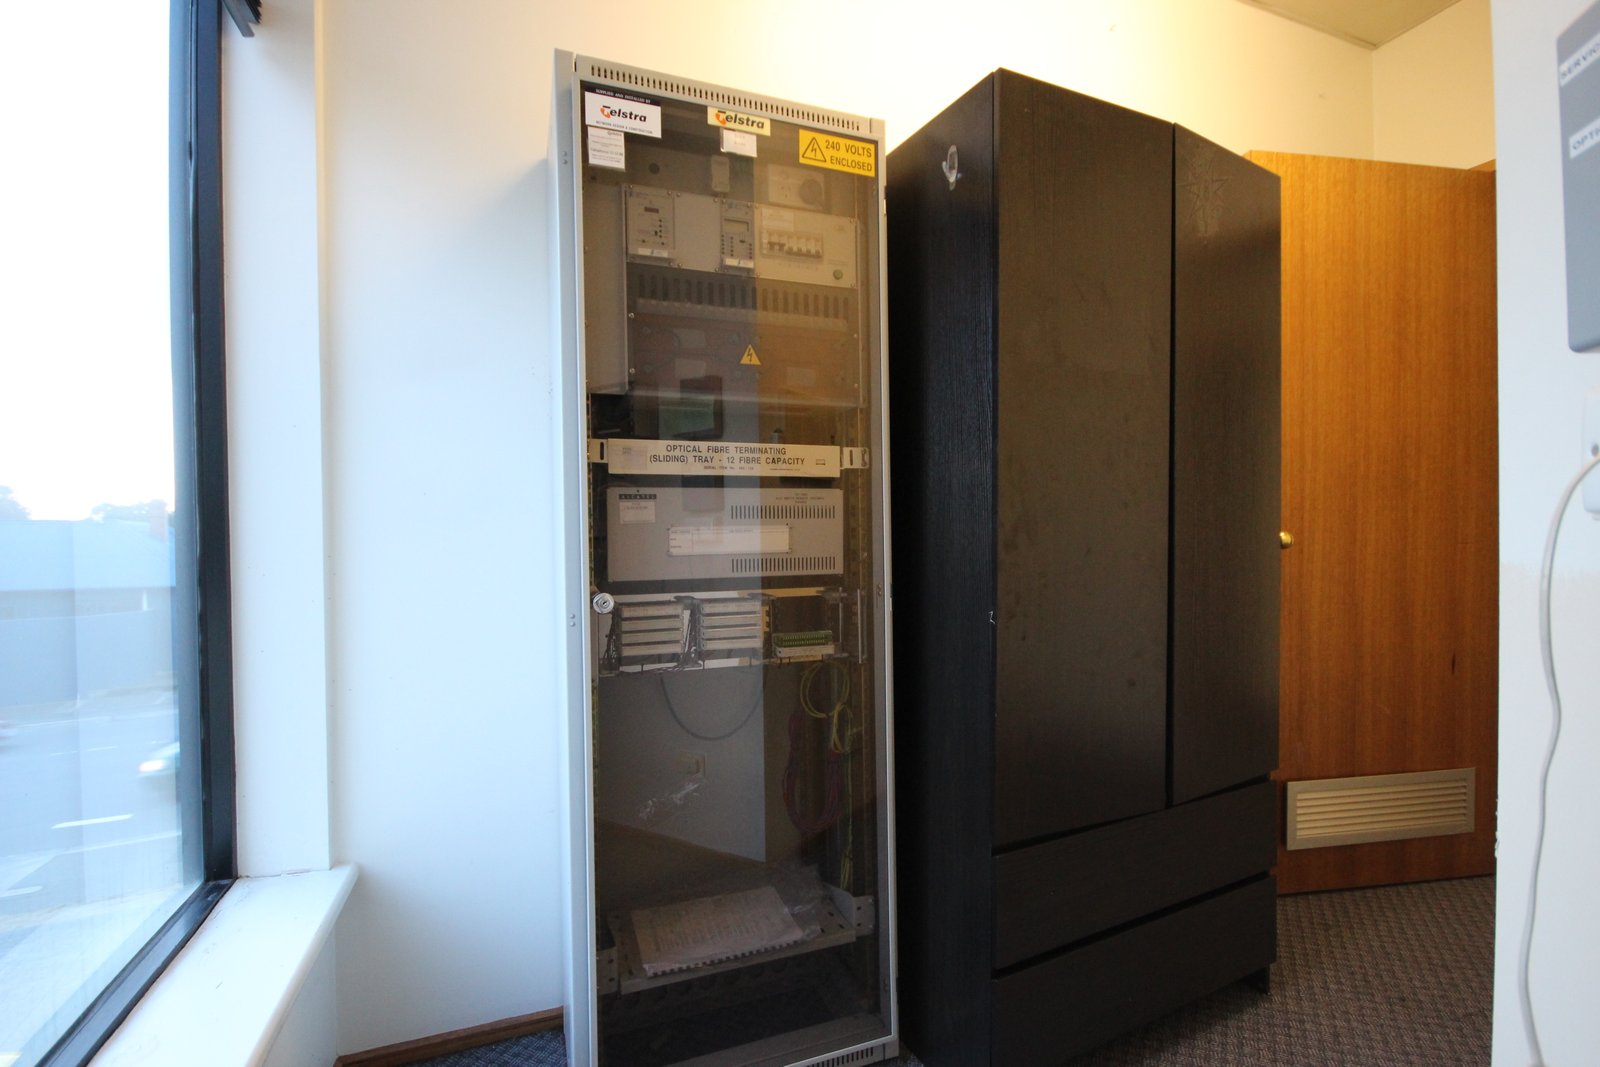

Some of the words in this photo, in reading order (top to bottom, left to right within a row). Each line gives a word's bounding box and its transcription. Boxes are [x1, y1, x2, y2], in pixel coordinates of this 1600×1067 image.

[600, 105, 647, 123] Telstra
[715, 110, 765, 129] Telstra
[825, 140, 840, 152] 240
[844, 143, 872, 158] VOLTS
[830, 155, 873, 172] ENCLOSED
[666, 444, 702, 453] OPTICAL
[707, 445, 730, 454] FIBRE
[734, 446, 787, 455] TERMINATING
[649, 454, 689, 464] (SLIDING)
[693, 455, 715, 463] TRAY
[727, 456, 735, 464] 12
[765, 457, 805, 465] CAPACITY
